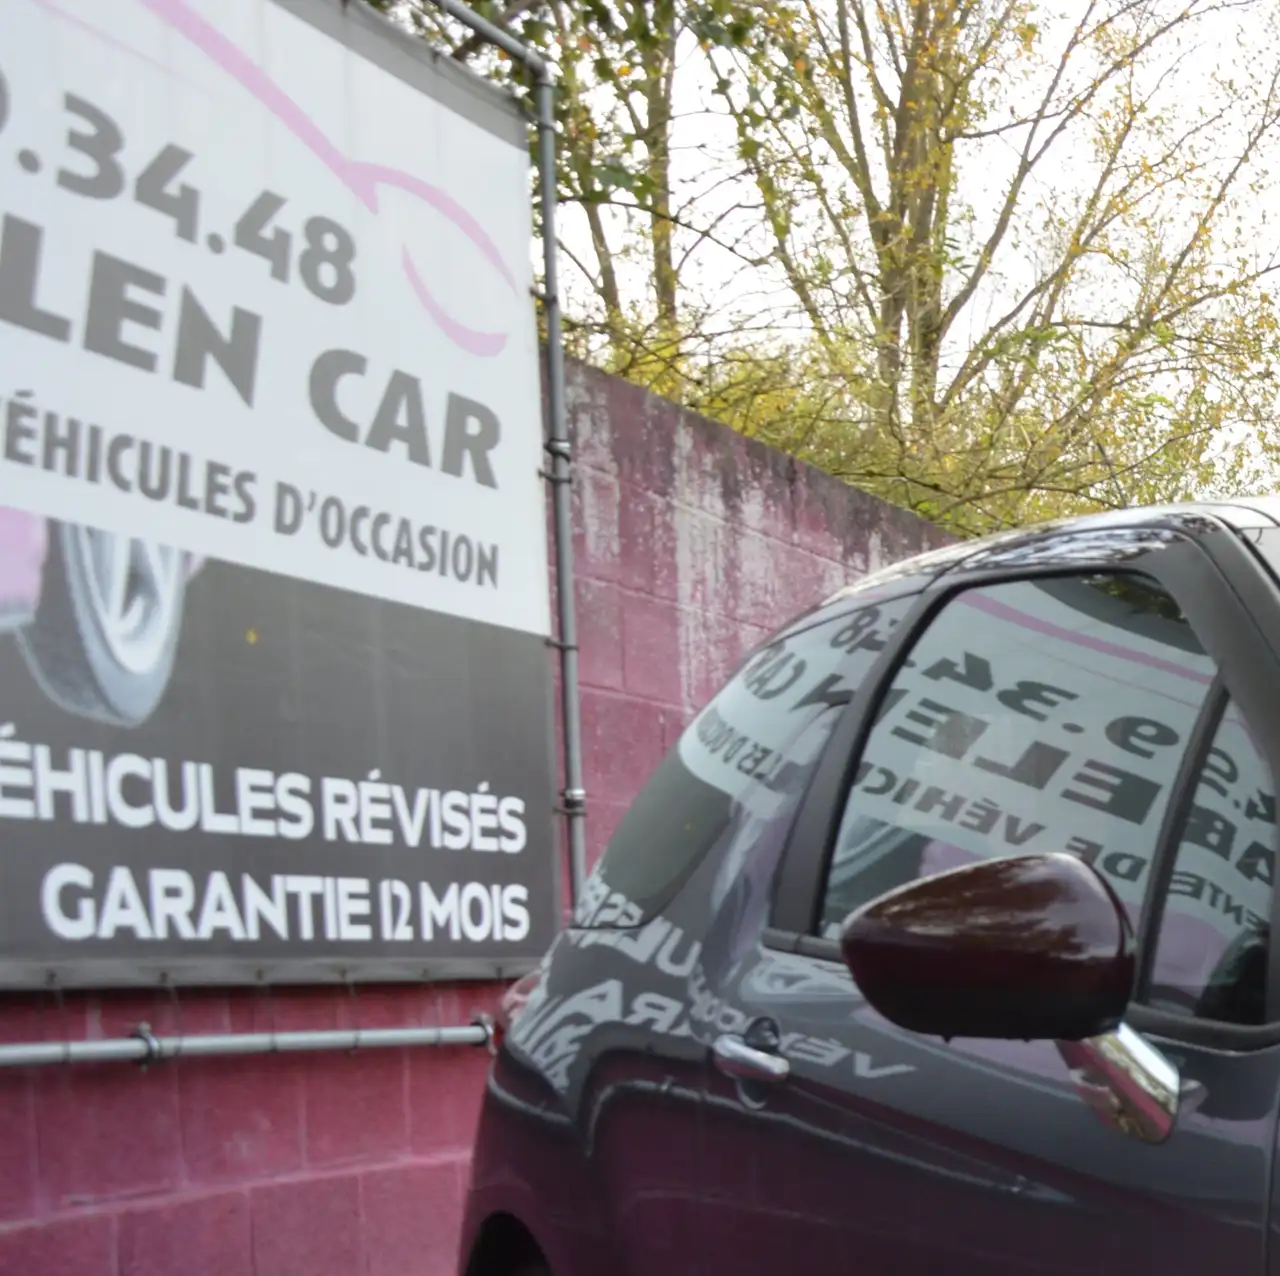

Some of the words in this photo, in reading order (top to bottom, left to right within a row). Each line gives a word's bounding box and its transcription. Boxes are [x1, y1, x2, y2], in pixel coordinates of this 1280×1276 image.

[0, 62, 357, 307] .34.48
[0, 212, 263, 410] LEN
[308, 347, 502, 490] CAR
[3, 388, 258, 525] ÉHICULES
[273, 480, 500, 590] D'OCCASION
[0, 722, 314, 841] ÉHICULES
[321, 768, 528, 855] RÉVISÉS
[41, 862, 371, 942] GARANTIE
[379, 879, 415, 942] 12
[419, 880, 531, 943] MOIS
